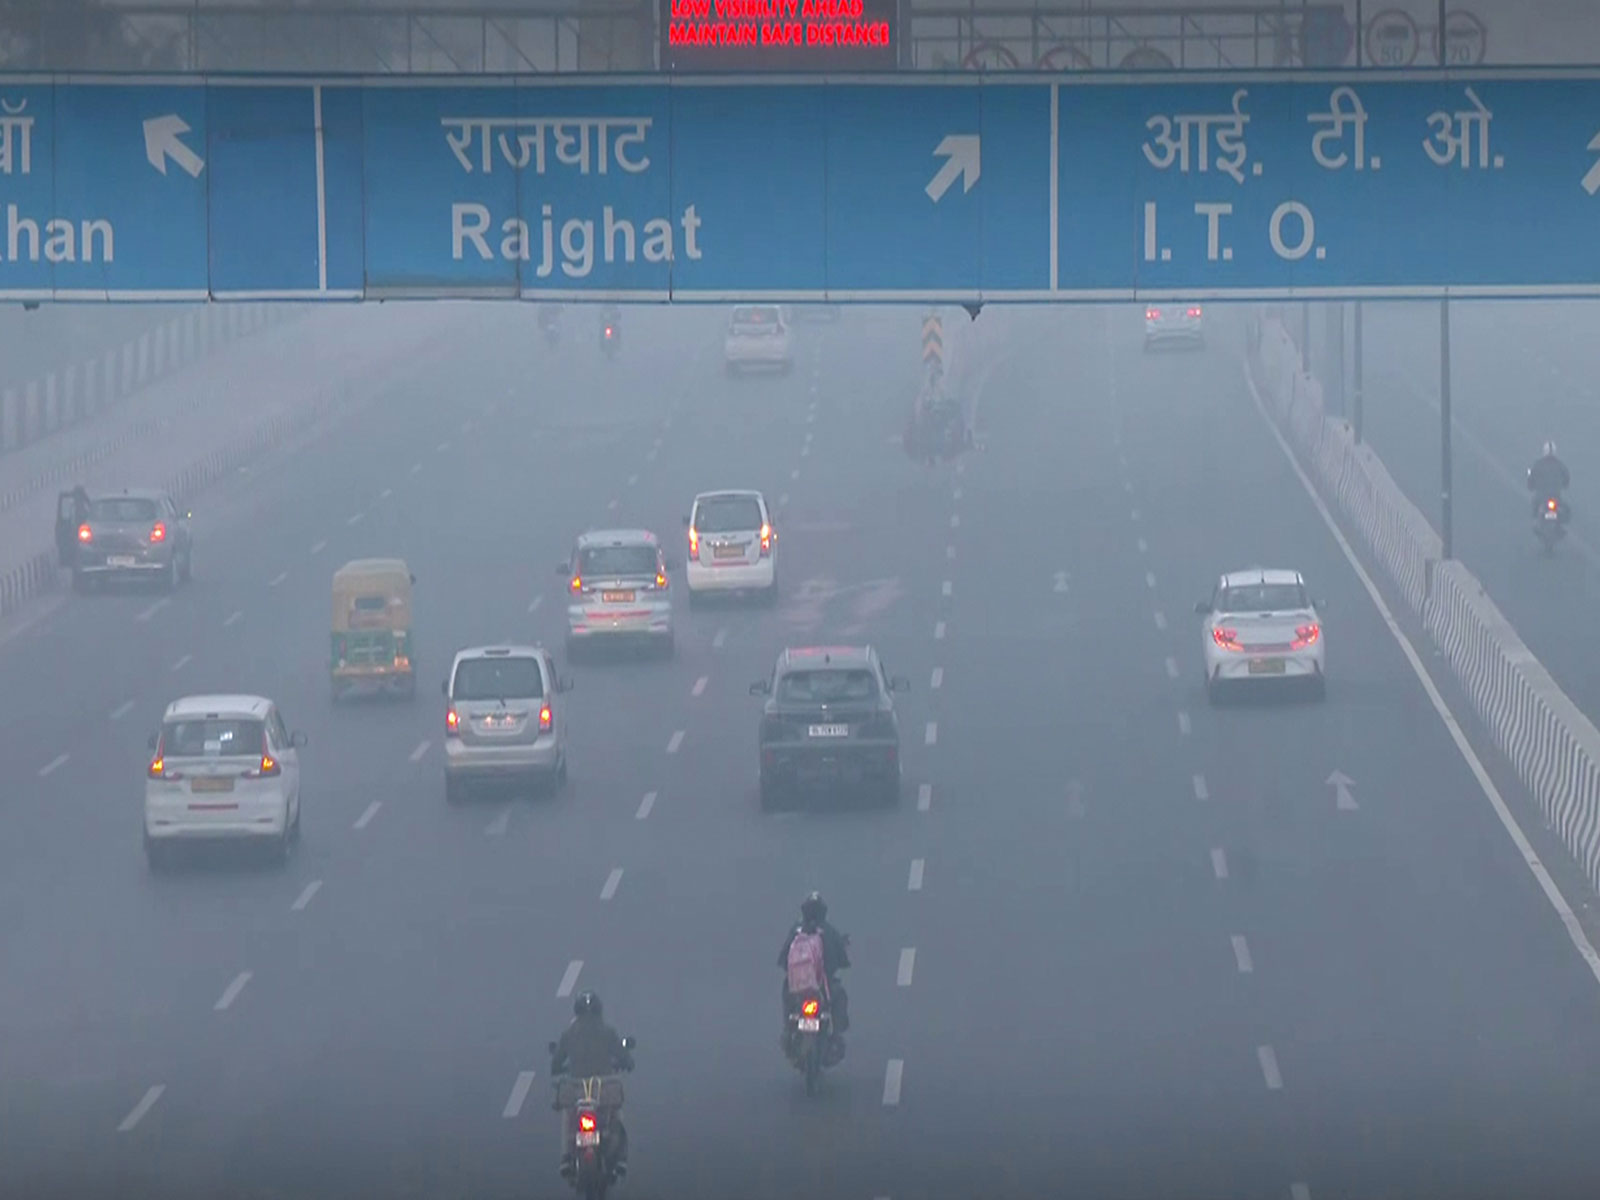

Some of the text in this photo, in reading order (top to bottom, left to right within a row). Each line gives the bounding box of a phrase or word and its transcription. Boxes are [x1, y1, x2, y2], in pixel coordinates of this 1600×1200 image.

[669, 23, 889, 45] MAINTAIN SAFE DISTANCE
[671, 0, 864, 18] LOW VISIBILITY AHEAD
[441, 117, 652, 174] राजघाट
[1142, 86, 1504, 184] आई. टी. ओ.
[0, 204, 114, 262] han
[452, 204, 702, 277] Rajghat
[1144, 201, 1326, 261] I. T. O.
